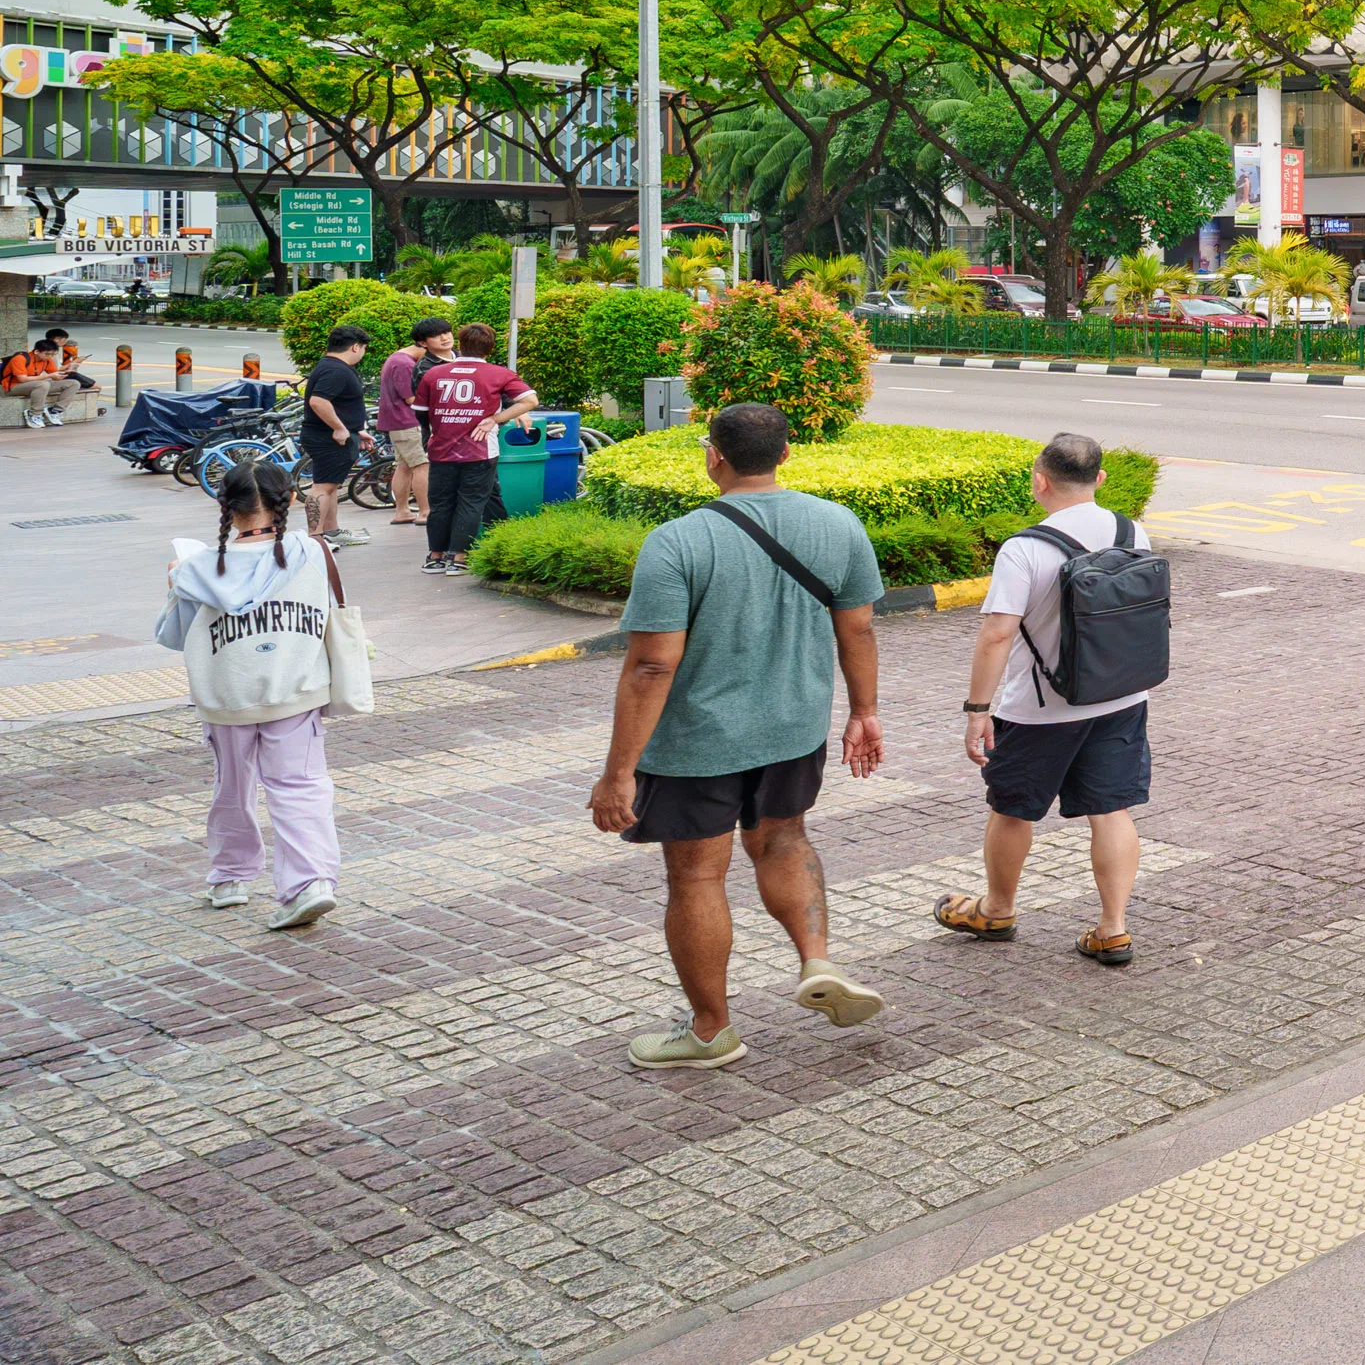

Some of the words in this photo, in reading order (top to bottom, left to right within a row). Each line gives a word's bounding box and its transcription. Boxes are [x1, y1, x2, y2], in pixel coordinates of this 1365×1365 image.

[294, 192, 322, 200] Middle
[325, 192, 337, 200] Rd
[289, 201, 324, 211] (Selegie
[327, 201, 342, 210] Rd)
[316, 216, 343, 224] Middle
[347, 216, 358, 224] Rd
[314, 225, 343, 234] (Beach
[346, 225, 361, 234] Rd)
[105, 239, 181, 252] VICTORIA
[188, 239, 208, 251] ST
[287, 241, 307, 249] Bras
[311, 240, 337, 249] Basah
[340, 240, 352, 248] Rd
[287, 251, 302, 259] Hill
[306, 250, 316, 258] St
[441, 416, 472, 424] SUBSIDY
